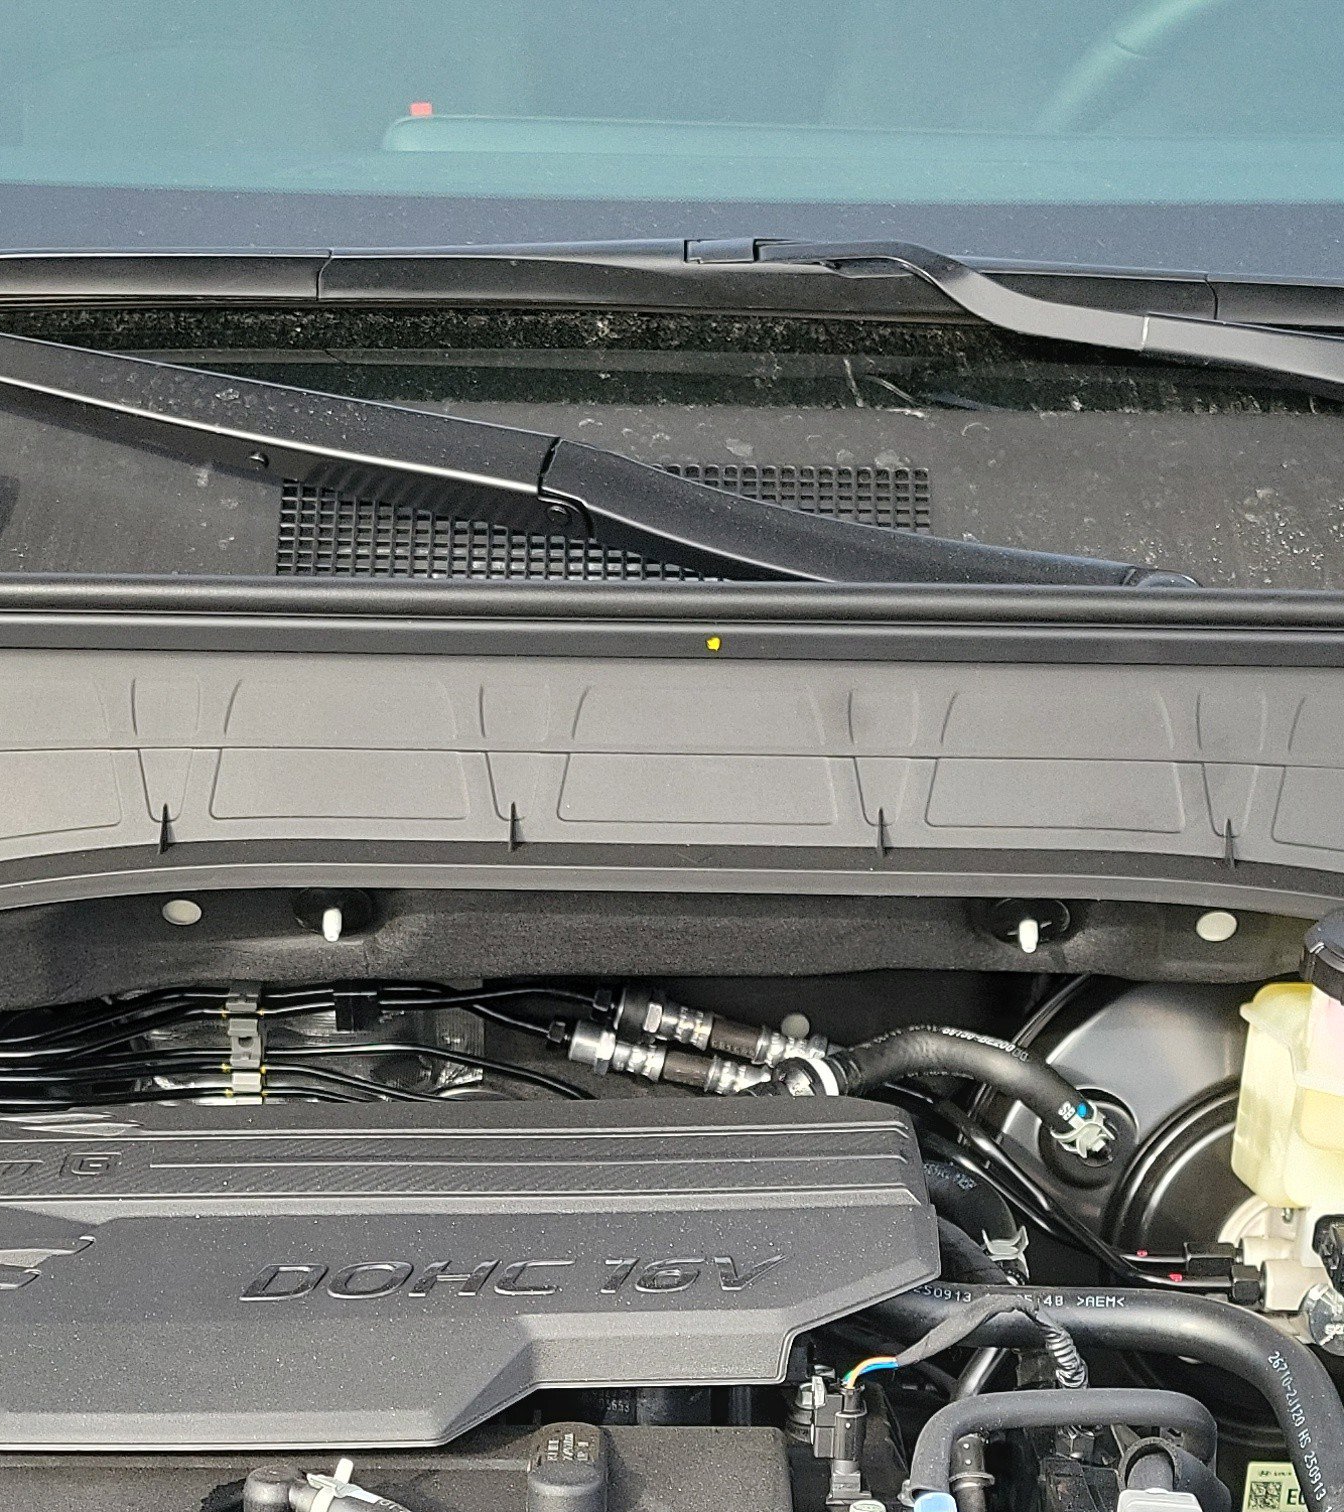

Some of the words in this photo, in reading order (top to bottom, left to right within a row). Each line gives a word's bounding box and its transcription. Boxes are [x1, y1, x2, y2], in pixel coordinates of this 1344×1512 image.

[240, 1259, 574, 1303] DOHC
[601, 1253, 788, 1296] 16V
[1297, 1430, 1313, 1450] HS
[1303, 1450, 1328, 1502] 250913
